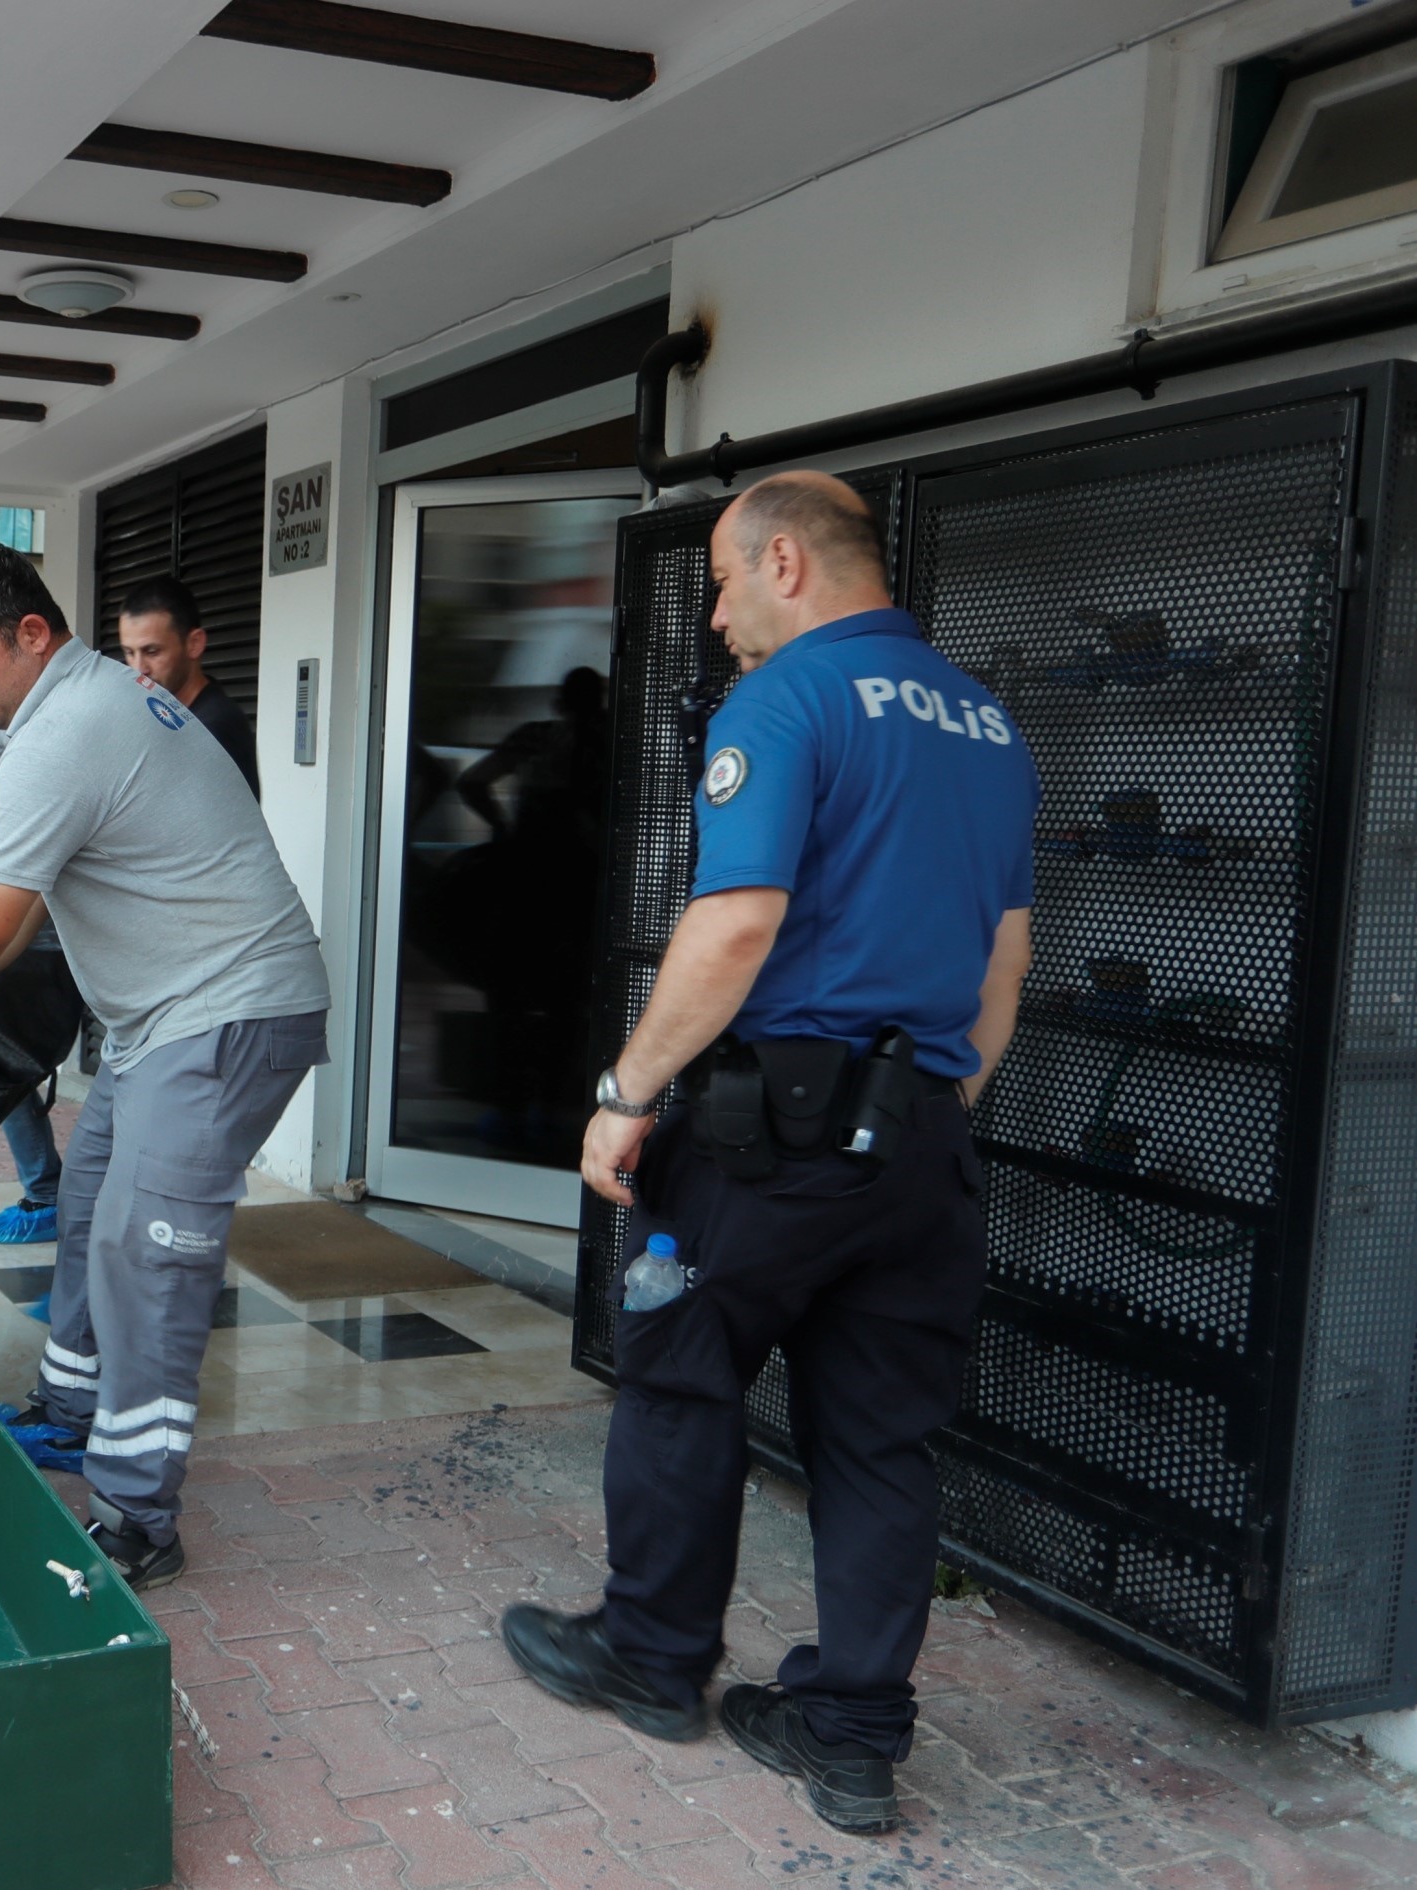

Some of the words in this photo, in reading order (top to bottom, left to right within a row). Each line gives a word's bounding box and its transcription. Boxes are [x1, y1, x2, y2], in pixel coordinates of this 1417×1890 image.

[276, 475, 324, 527] ŞAN
[275, 518, 322, 543] APARTMANI
[283, 543, 299, 563] NO
